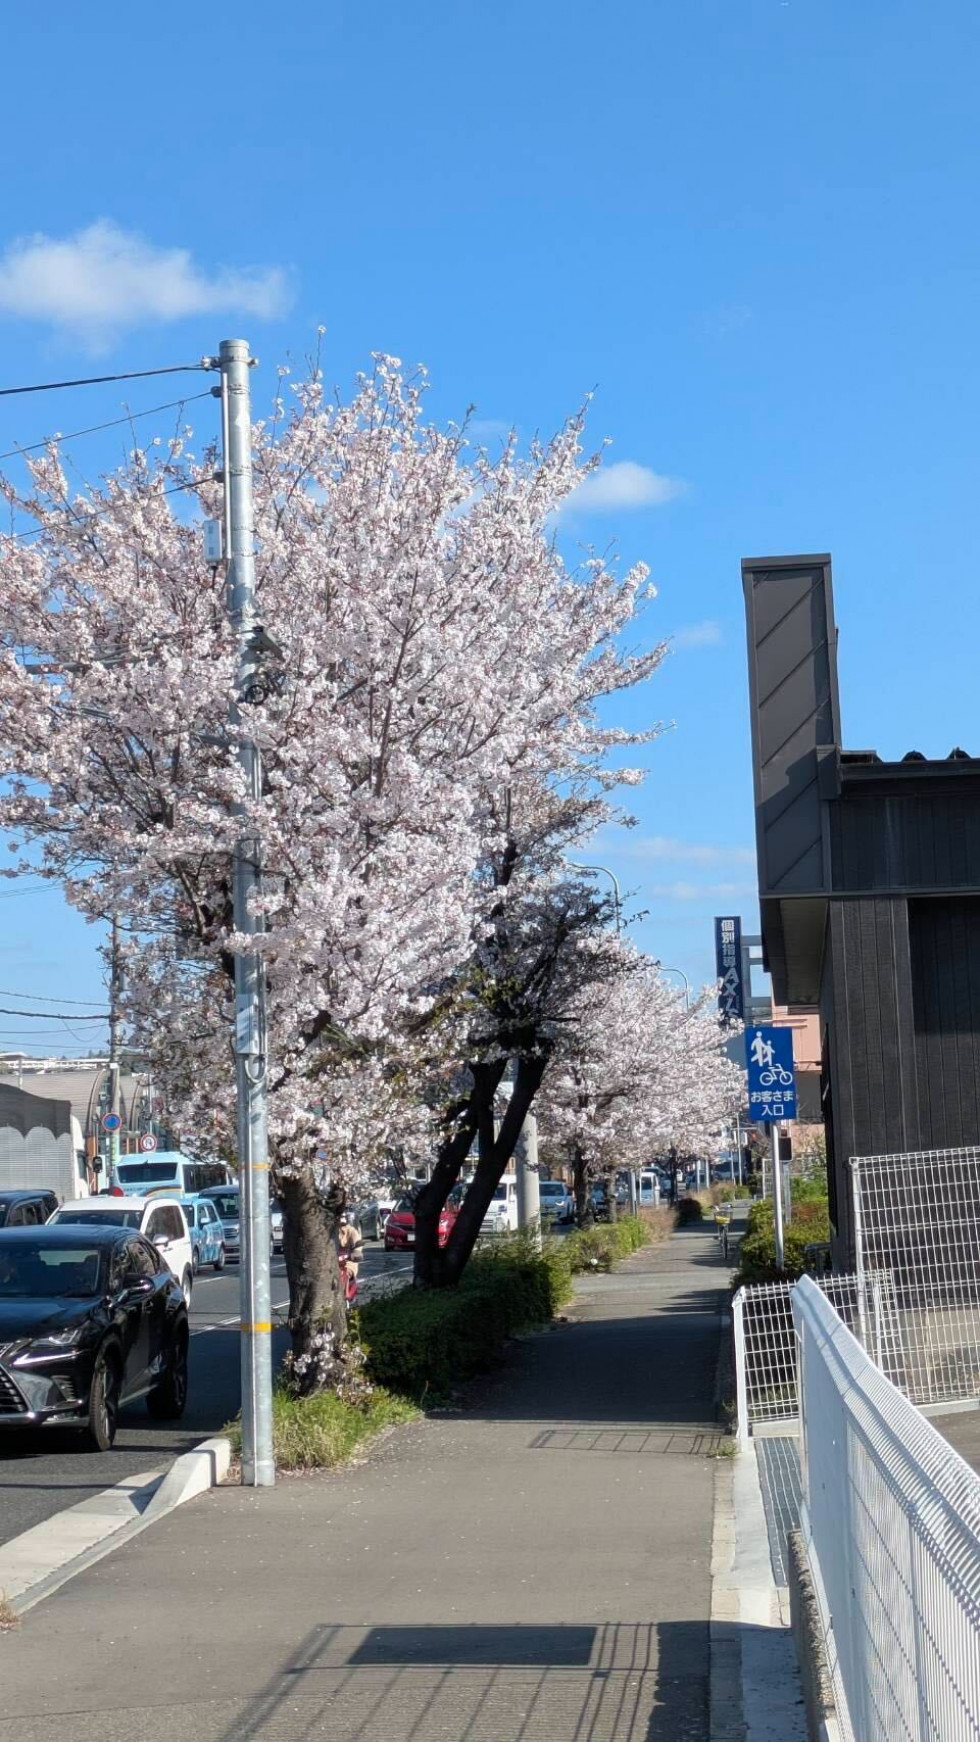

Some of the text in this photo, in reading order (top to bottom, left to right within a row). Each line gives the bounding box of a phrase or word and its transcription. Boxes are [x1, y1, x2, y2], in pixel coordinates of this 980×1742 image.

[751, 1091, 794, 1103] お客さま
[761, 1104, 784, 1116] 入口
